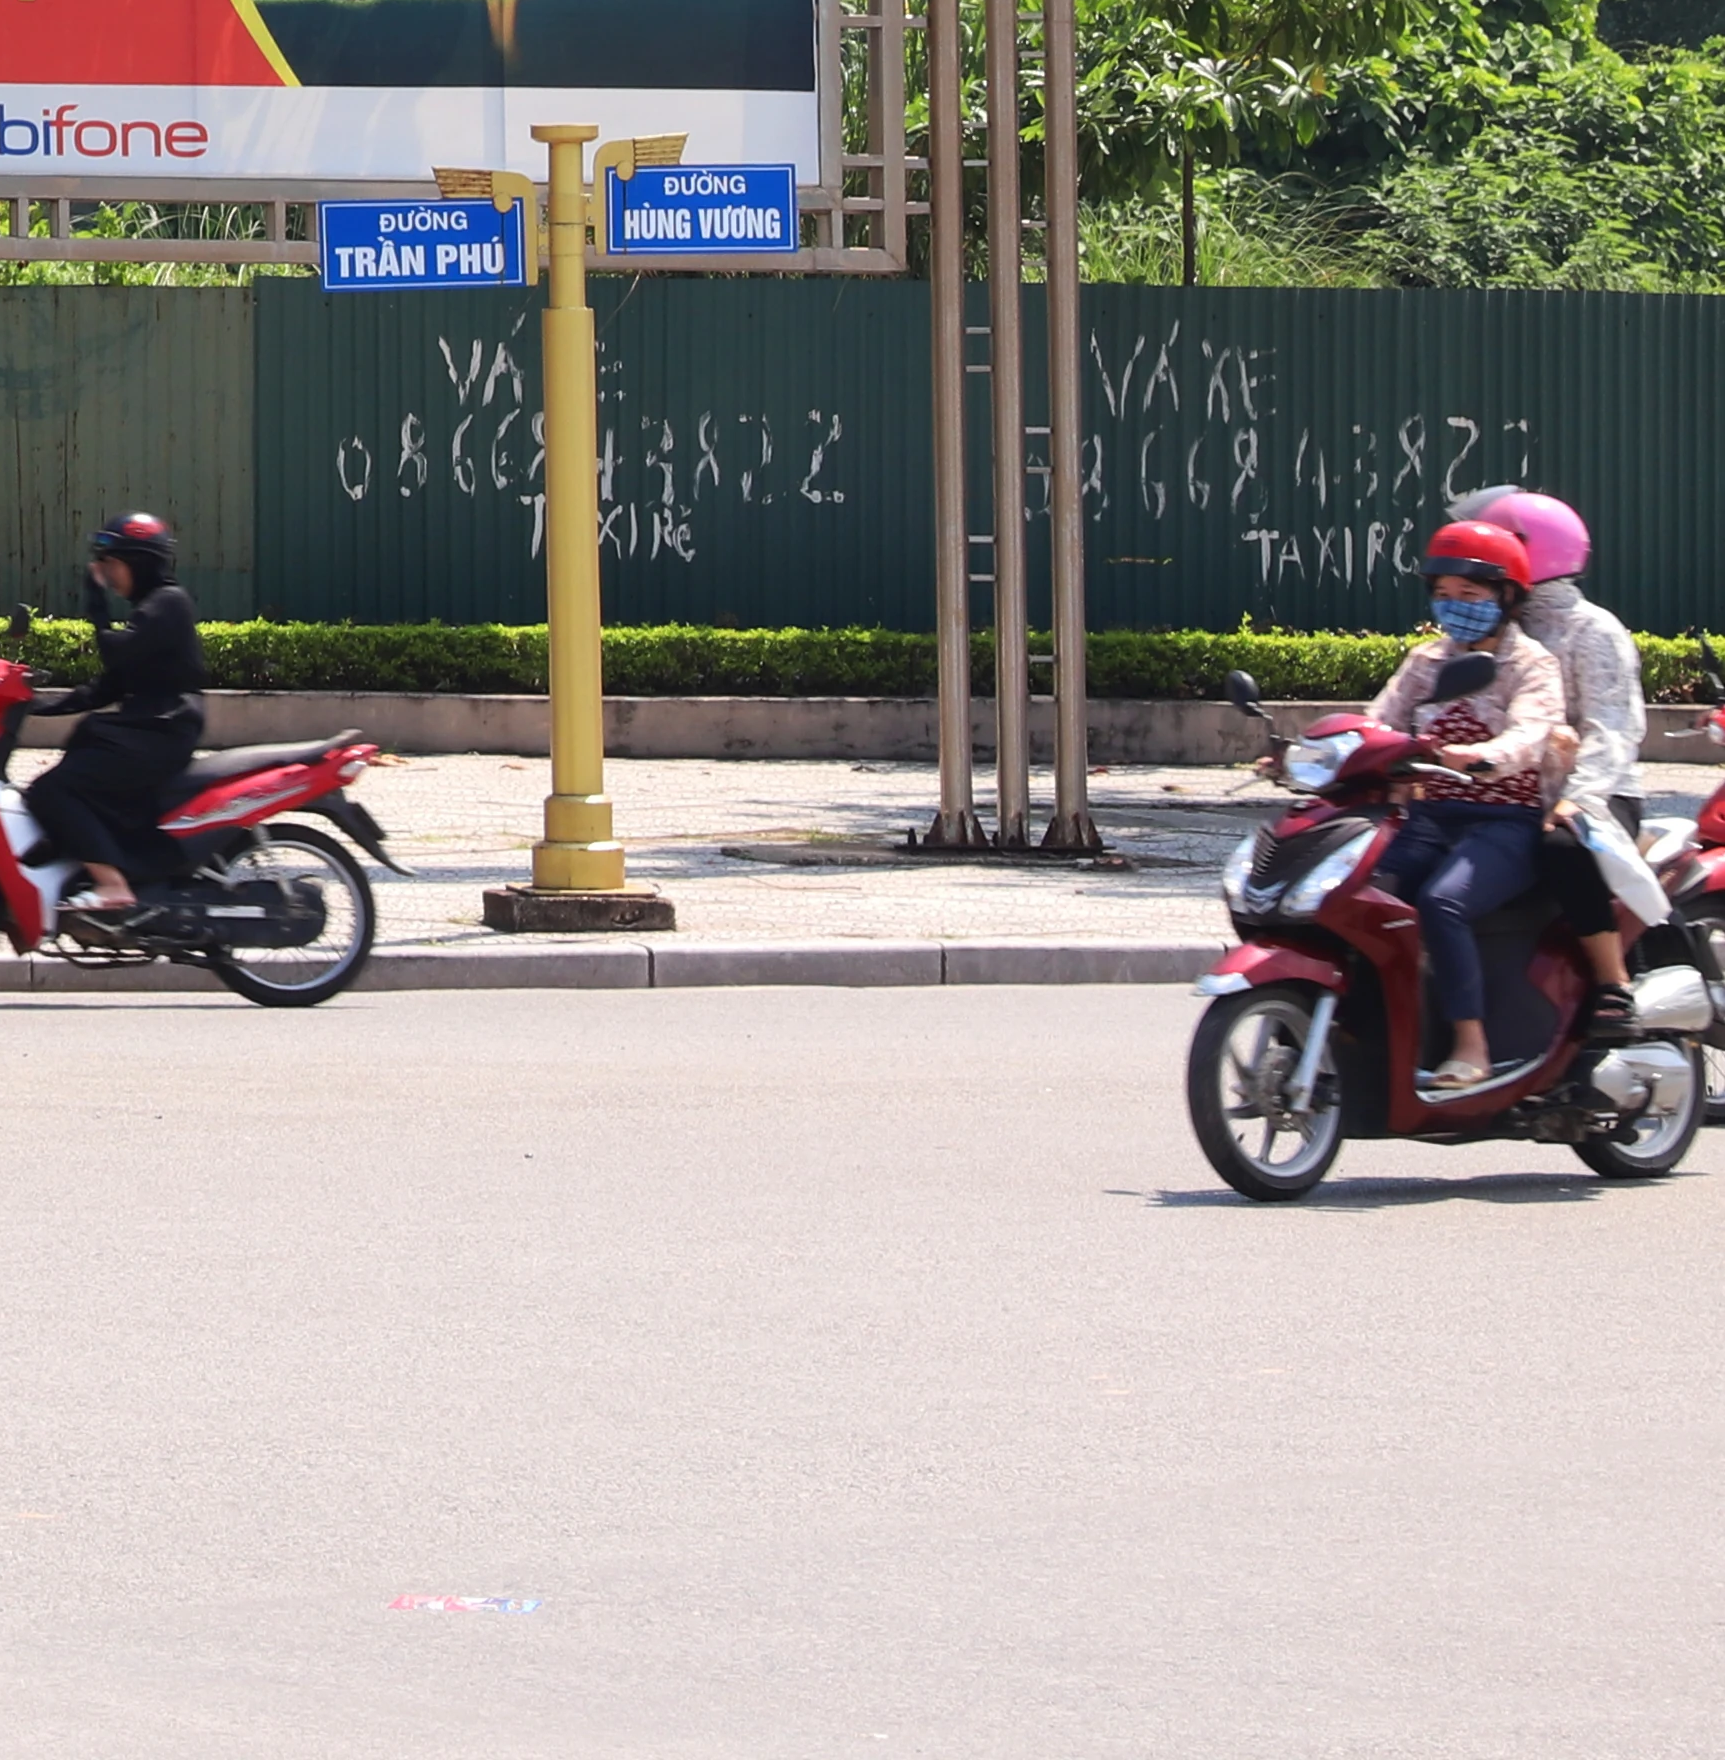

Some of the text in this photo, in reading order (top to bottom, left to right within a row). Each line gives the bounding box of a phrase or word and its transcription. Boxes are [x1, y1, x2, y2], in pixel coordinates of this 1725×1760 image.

[665, 174, 745, 195] ĐƯỜNG
[380, 210, 467, 232] ĐƯỜNG
[625, 203, 780, 239] HÙNG VƯƠNG
[336, 236, 504, 277] TRẦN PHÚ
[521, 493, 637, 561] TXI
